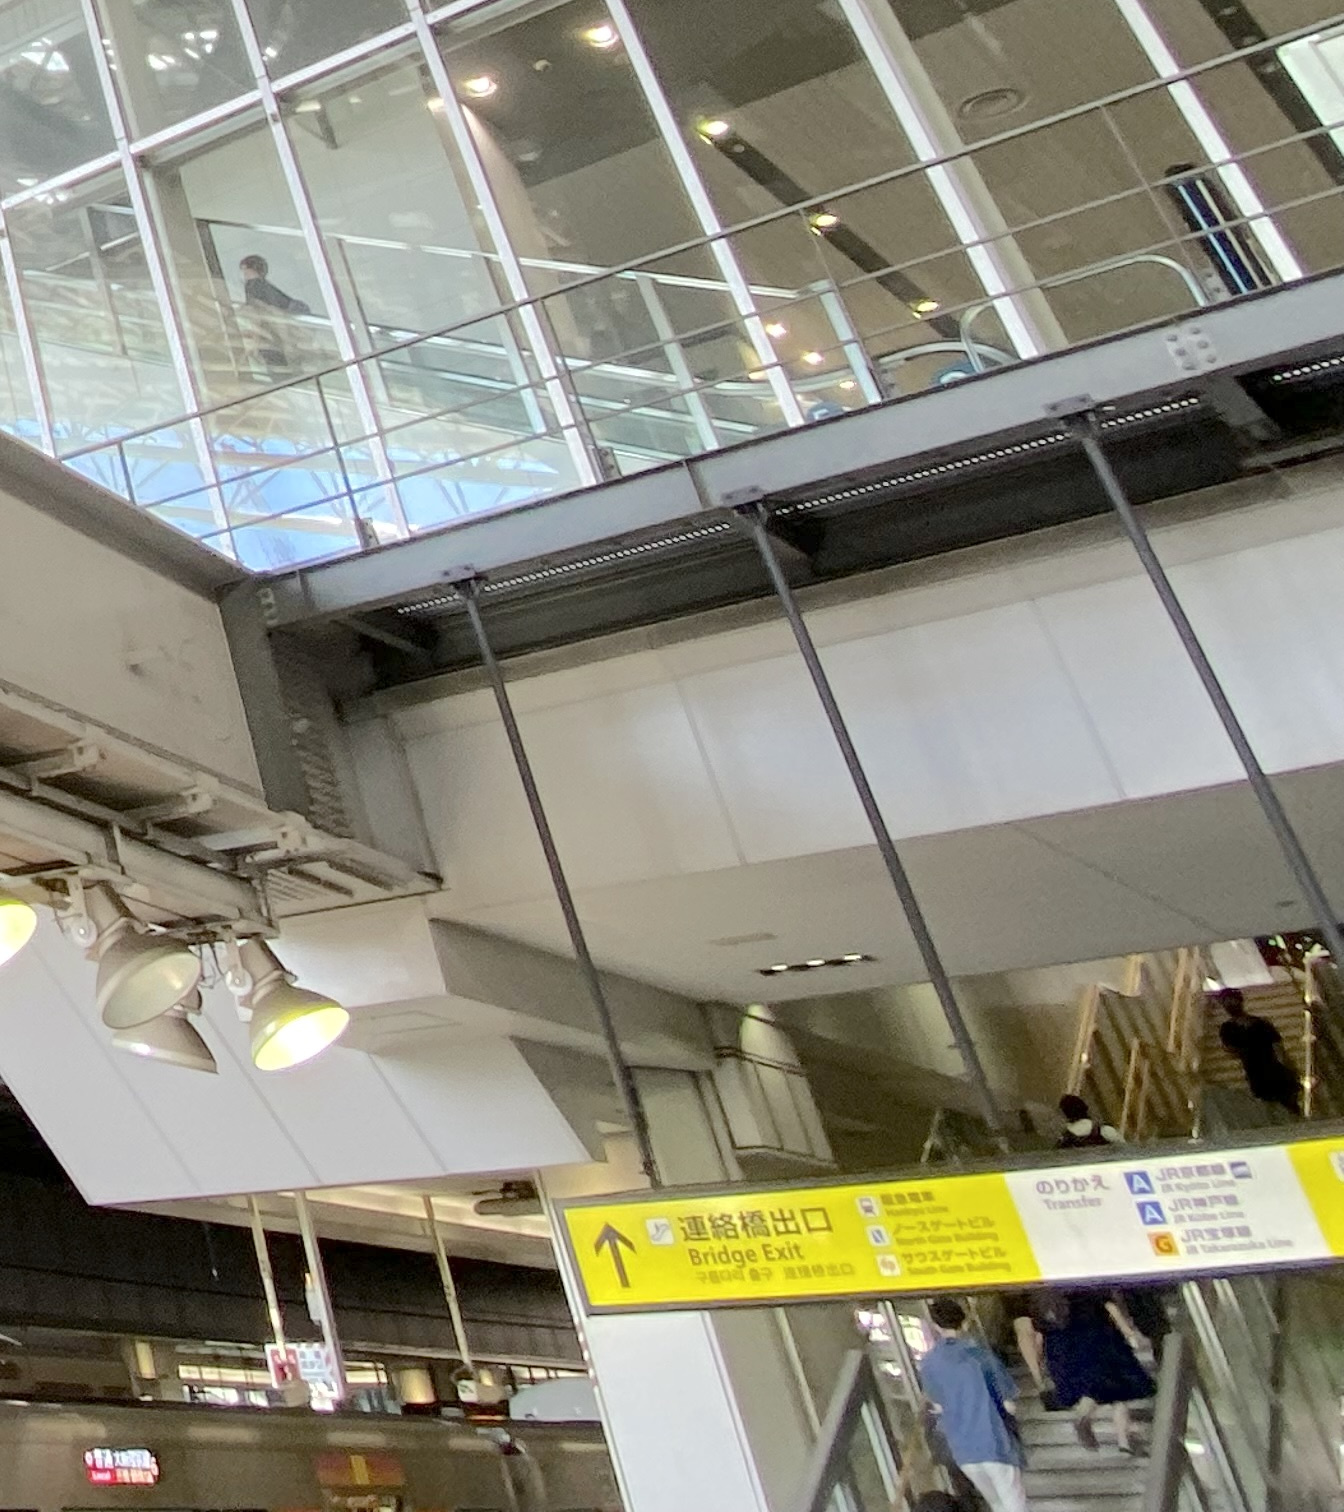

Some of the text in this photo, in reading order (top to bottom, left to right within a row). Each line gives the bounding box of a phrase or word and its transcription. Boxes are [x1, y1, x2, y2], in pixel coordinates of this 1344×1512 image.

[1035, 1174, 1110, 1196] のりかえ
[1043, 1195, 1103, 1211] Transfer
[677, 1206, 833, 1242] 連絡橋出口
[688, 1241, 804, 1268] Bridge Exit
